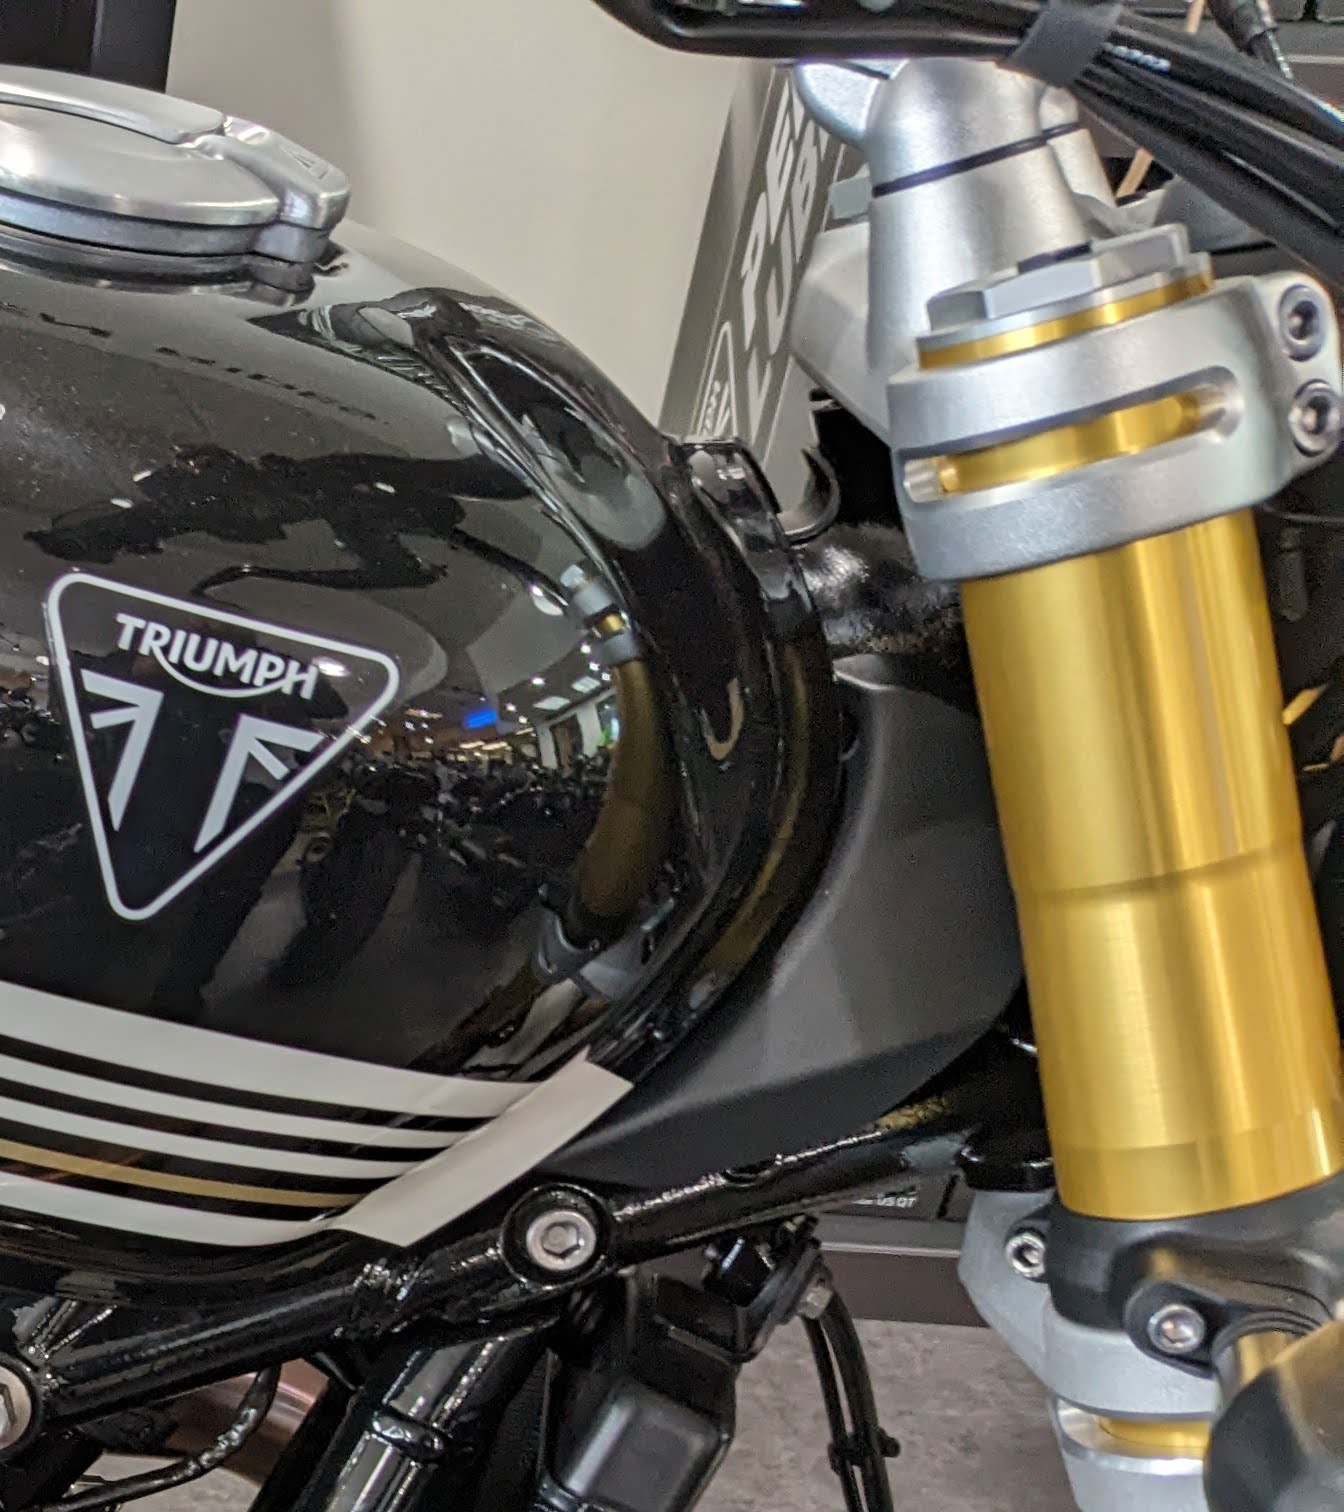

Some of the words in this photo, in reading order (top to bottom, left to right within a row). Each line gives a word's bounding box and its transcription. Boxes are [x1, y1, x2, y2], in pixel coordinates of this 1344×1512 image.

[740, 72, 805, 352] PE
[747, 119, 830, 445] LUB
[115, 612, 319, 700] TRIUMPH
